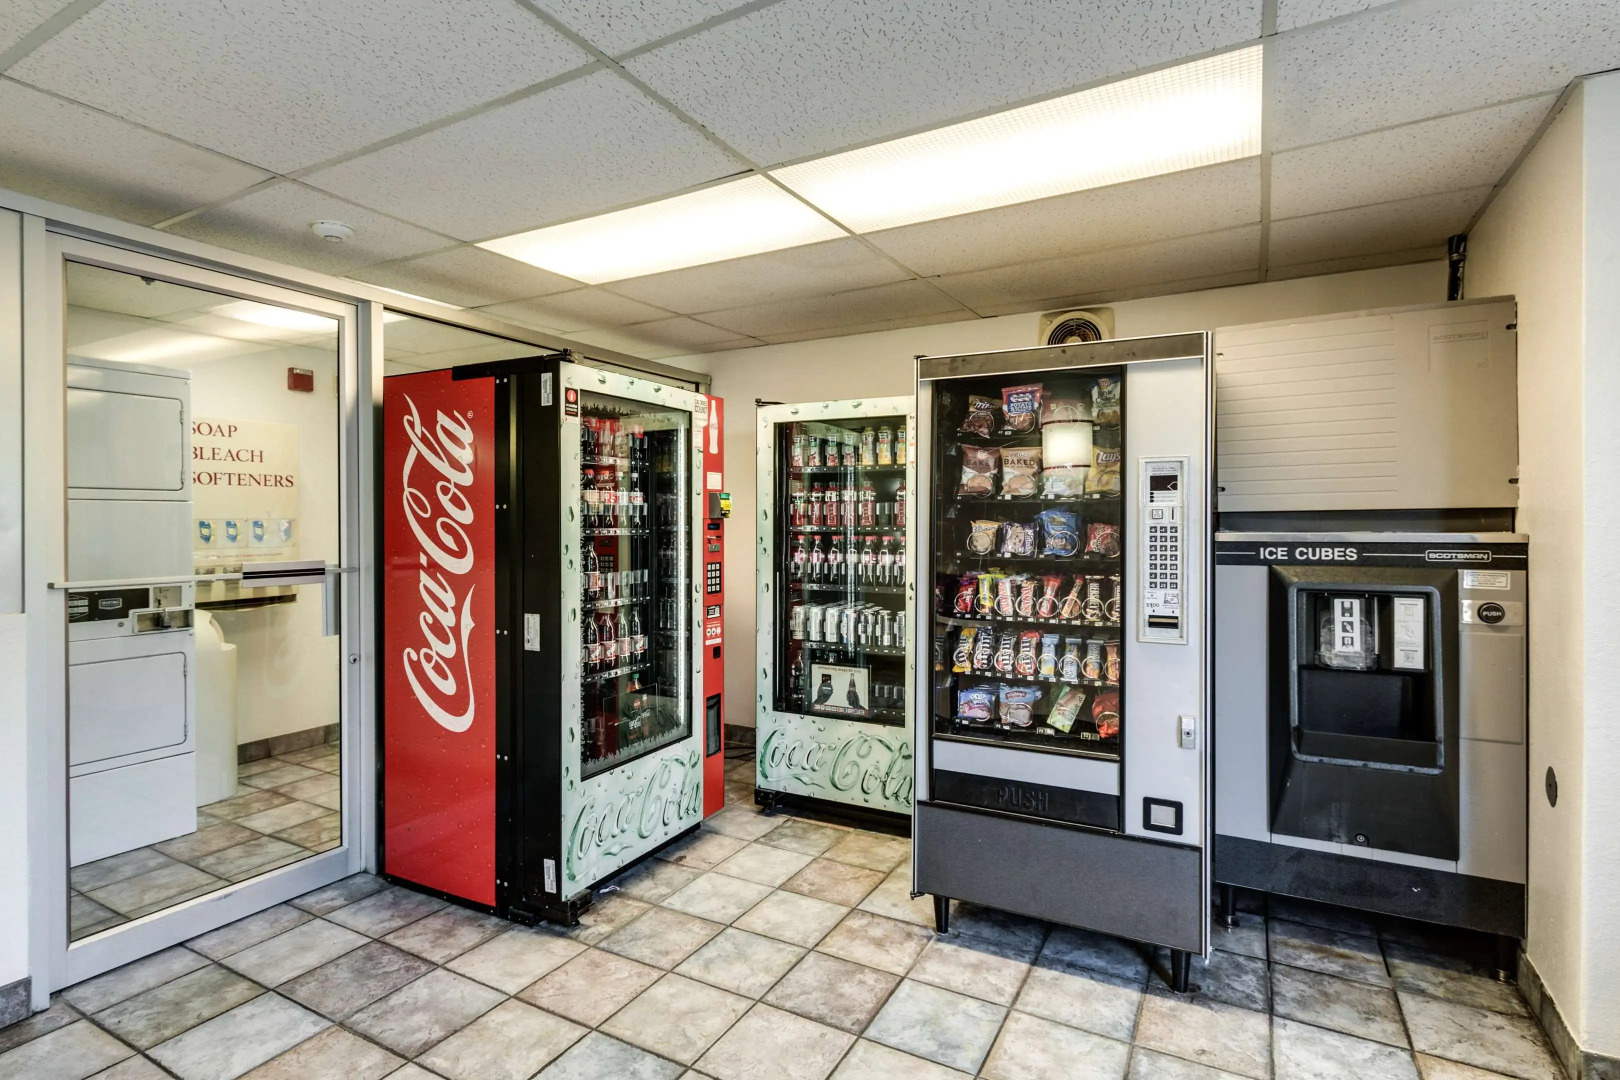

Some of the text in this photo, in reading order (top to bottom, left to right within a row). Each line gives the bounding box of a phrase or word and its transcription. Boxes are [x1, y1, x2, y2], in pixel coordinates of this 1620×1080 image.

[193, 446, 264, 463] BLEACH
[403, 393, 474, 732] Coca-Cola
[1260, 547, 1358, 560] ICE CUBES
[996, 786, 1049, 813] PUSH
[566, 750, 701, 882] Coca-Cola
